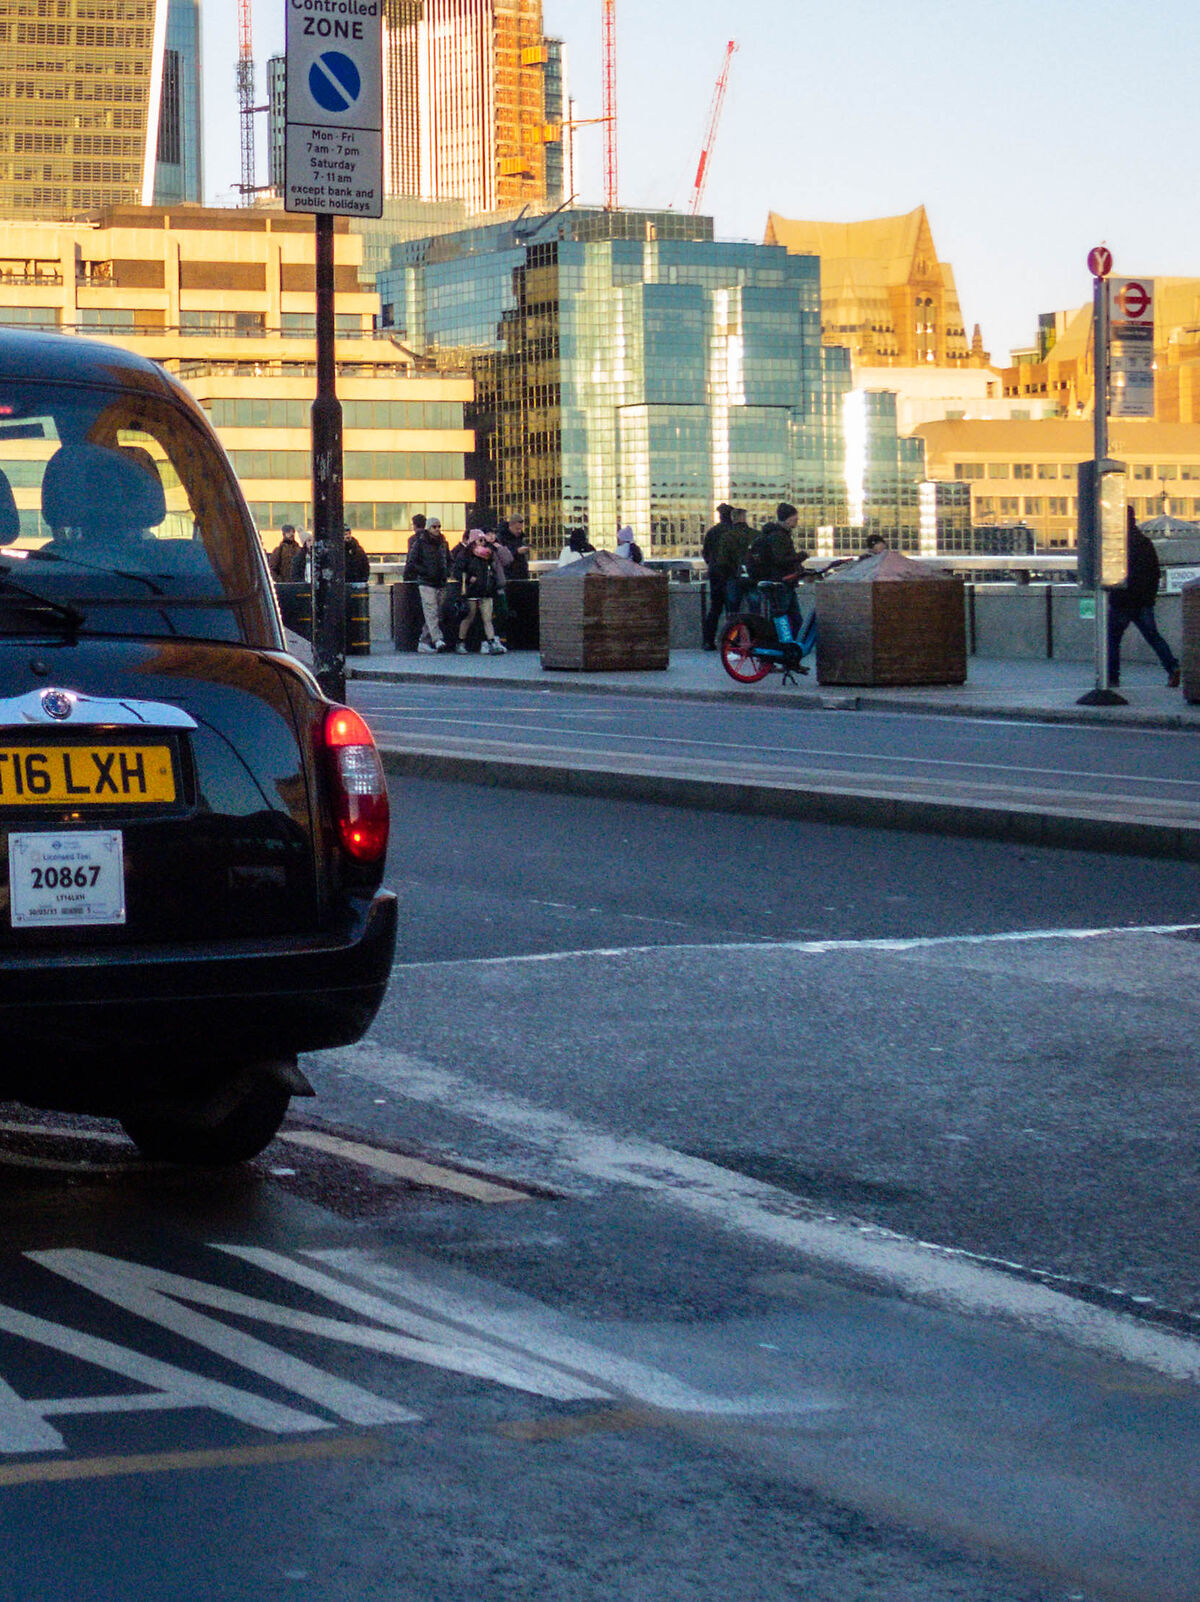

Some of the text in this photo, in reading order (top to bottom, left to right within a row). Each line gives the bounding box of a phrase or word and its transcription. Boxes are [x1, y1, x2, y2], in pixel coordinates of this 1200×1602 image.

[292, 0, 377, 16] Controlled
[303, 17, 364, 39] ZONE
[312, 129, 333, 140] Mon
[341, 131, 355, 142] Fri
[310, 157, 355, 172] Saturday
[291, 184, 374, 199] except bank and
[294, 197, 370, 211] public holidays
[1094, 251, 1108, 273] Y
[63, 752, 147, 794] LXH
[30, 865, 101, 890] 20867
